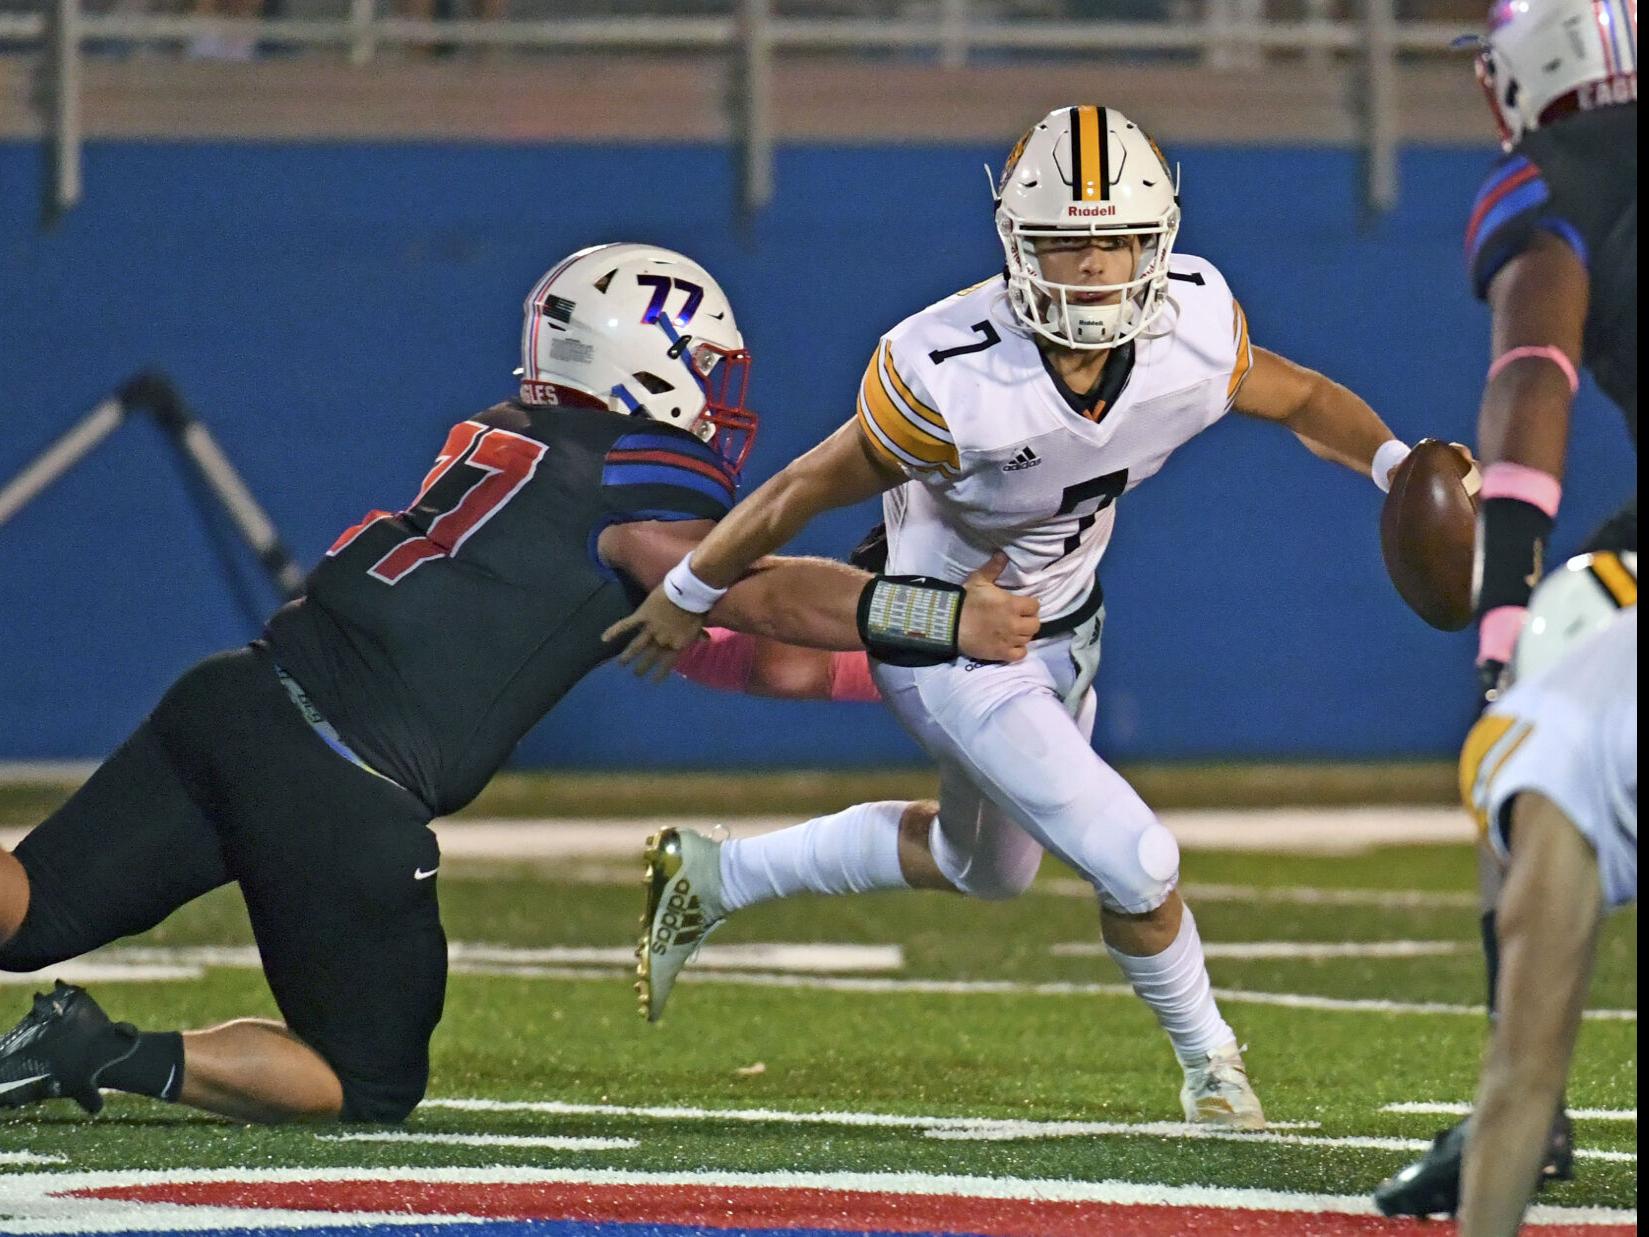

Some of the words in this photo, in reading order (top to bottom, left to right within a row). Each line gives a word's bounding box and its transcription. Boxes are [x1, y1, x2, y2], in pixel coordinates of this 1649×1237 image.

[1068, 205, 1116, 216] Riddell
[637, 274, 704, 327] 77
[928, 319, 1002, 365] 7
[1002, 457, 1042, 472] adidas
[1043, 467, 1129, 571] 7
[651, 877, 690, 957] adidas
